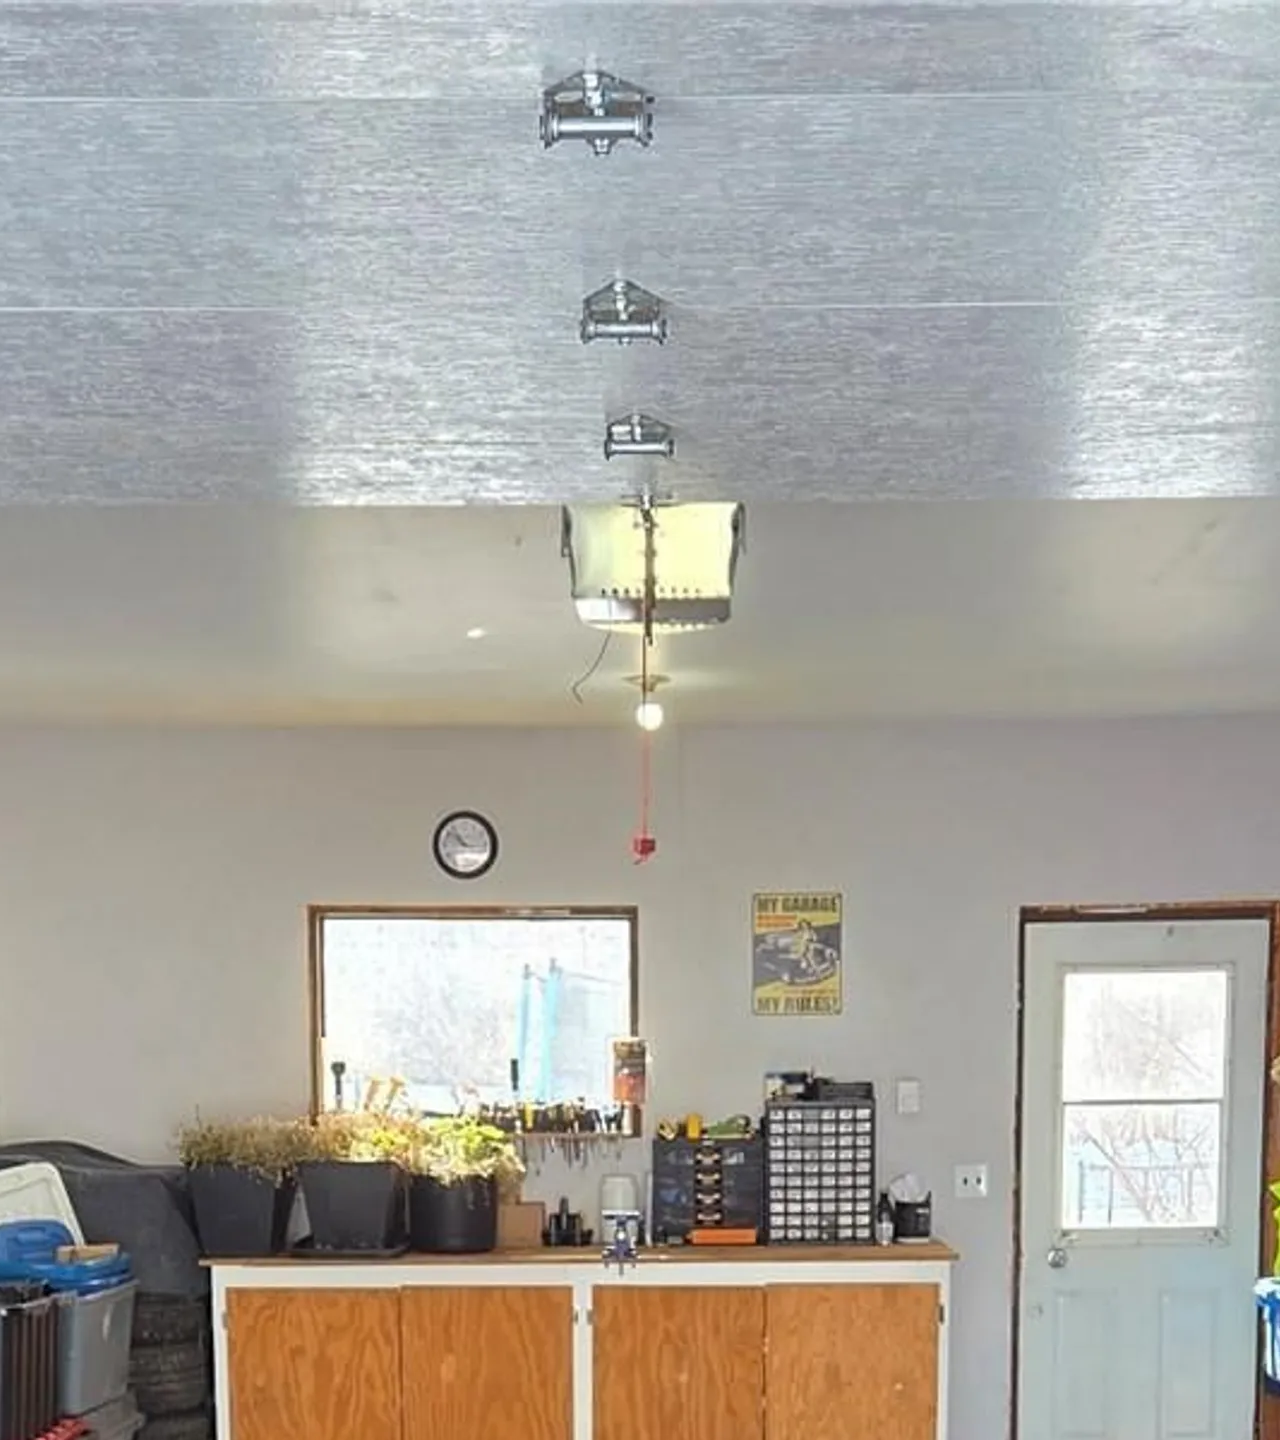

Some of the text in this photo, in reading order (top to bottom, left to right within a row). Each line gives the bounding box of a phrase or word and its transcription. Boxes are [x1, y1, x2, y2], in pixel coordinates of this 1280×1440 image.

[757, 897, 837, 913] MY GARAGE
[757, 997, 779, 1012] MY
